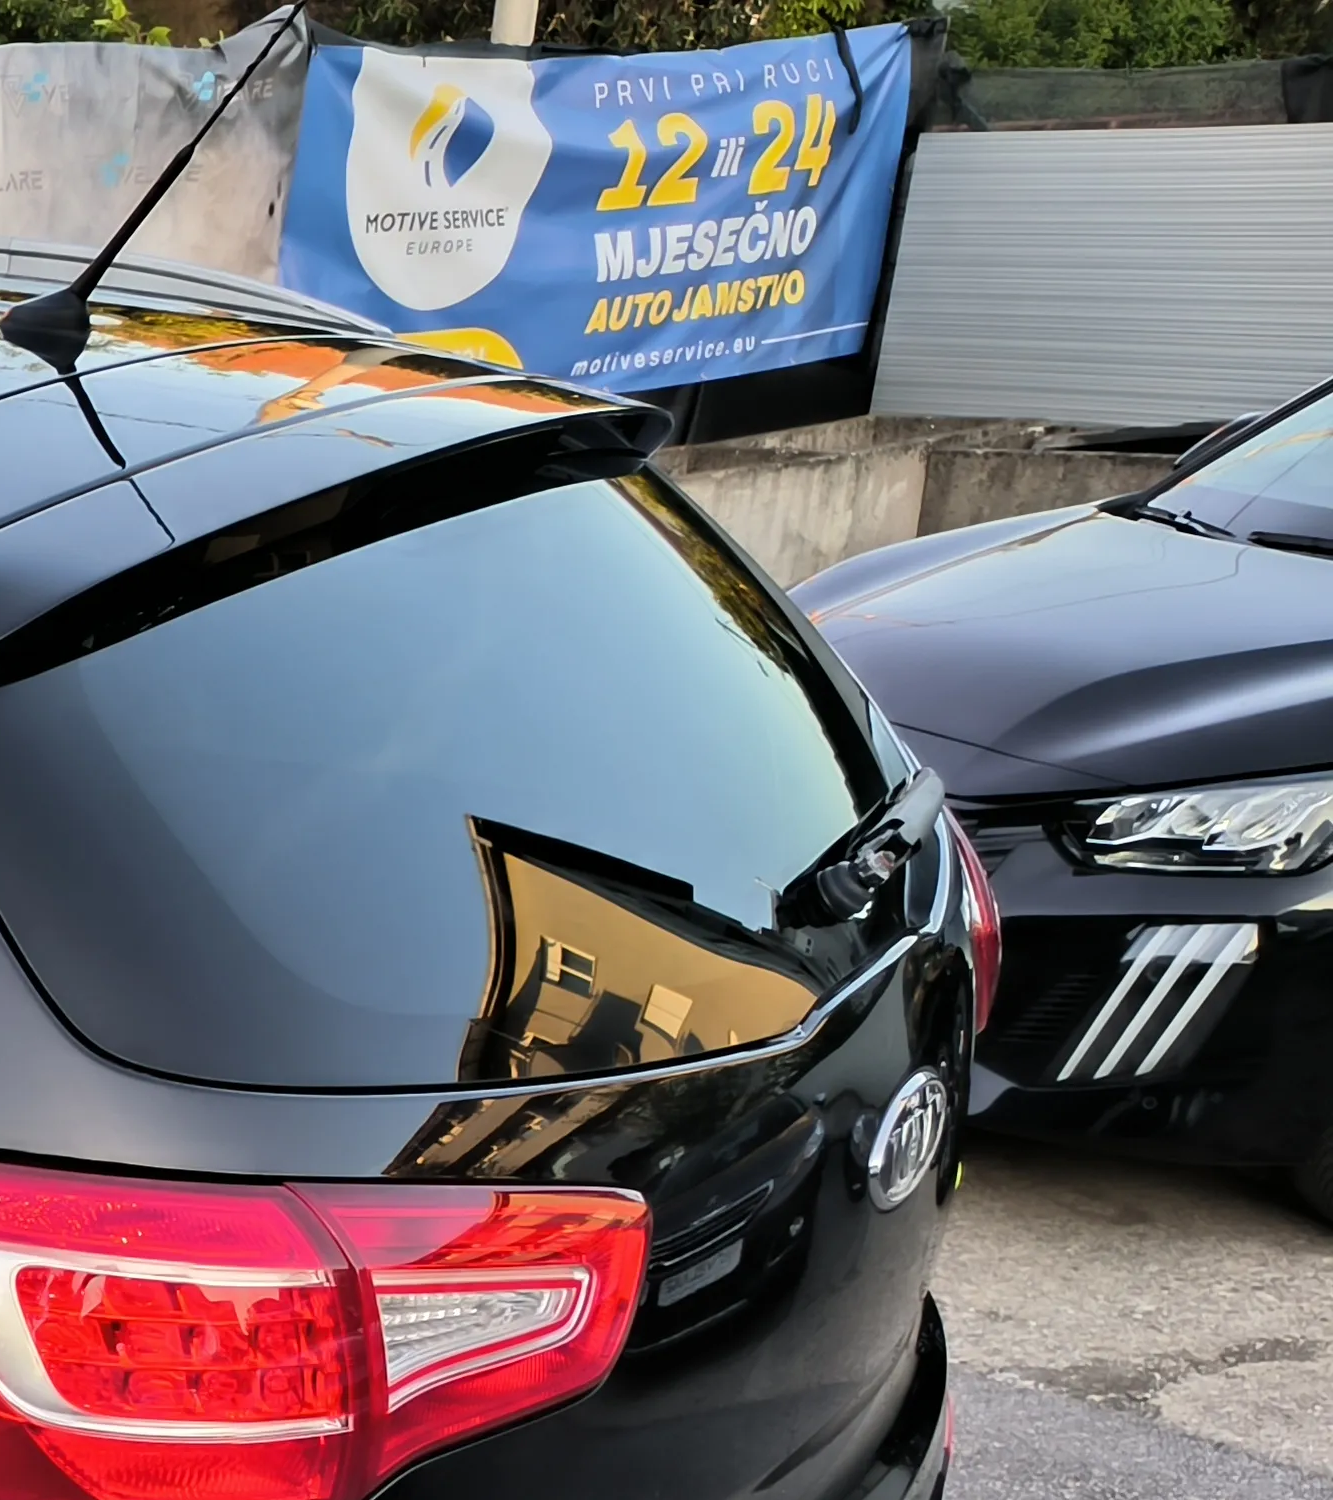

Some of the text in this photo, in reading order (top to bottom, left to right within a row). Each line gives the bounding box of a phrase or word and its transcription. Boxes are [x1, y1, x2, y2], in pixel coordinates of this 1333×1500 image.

[594, 76, 671, 108] PRVI
[764, 58, 834, 88] RUCI
[596, 94, 836, 211] 12 ili 24
[365, 208, 505, 234] MOTIVE SERVICE
[594, 200, 817, 282] MJESEČNO
[405, 238, 473, 256] EUROPE
[570, 336, 755, 376] motiveservice.eu
